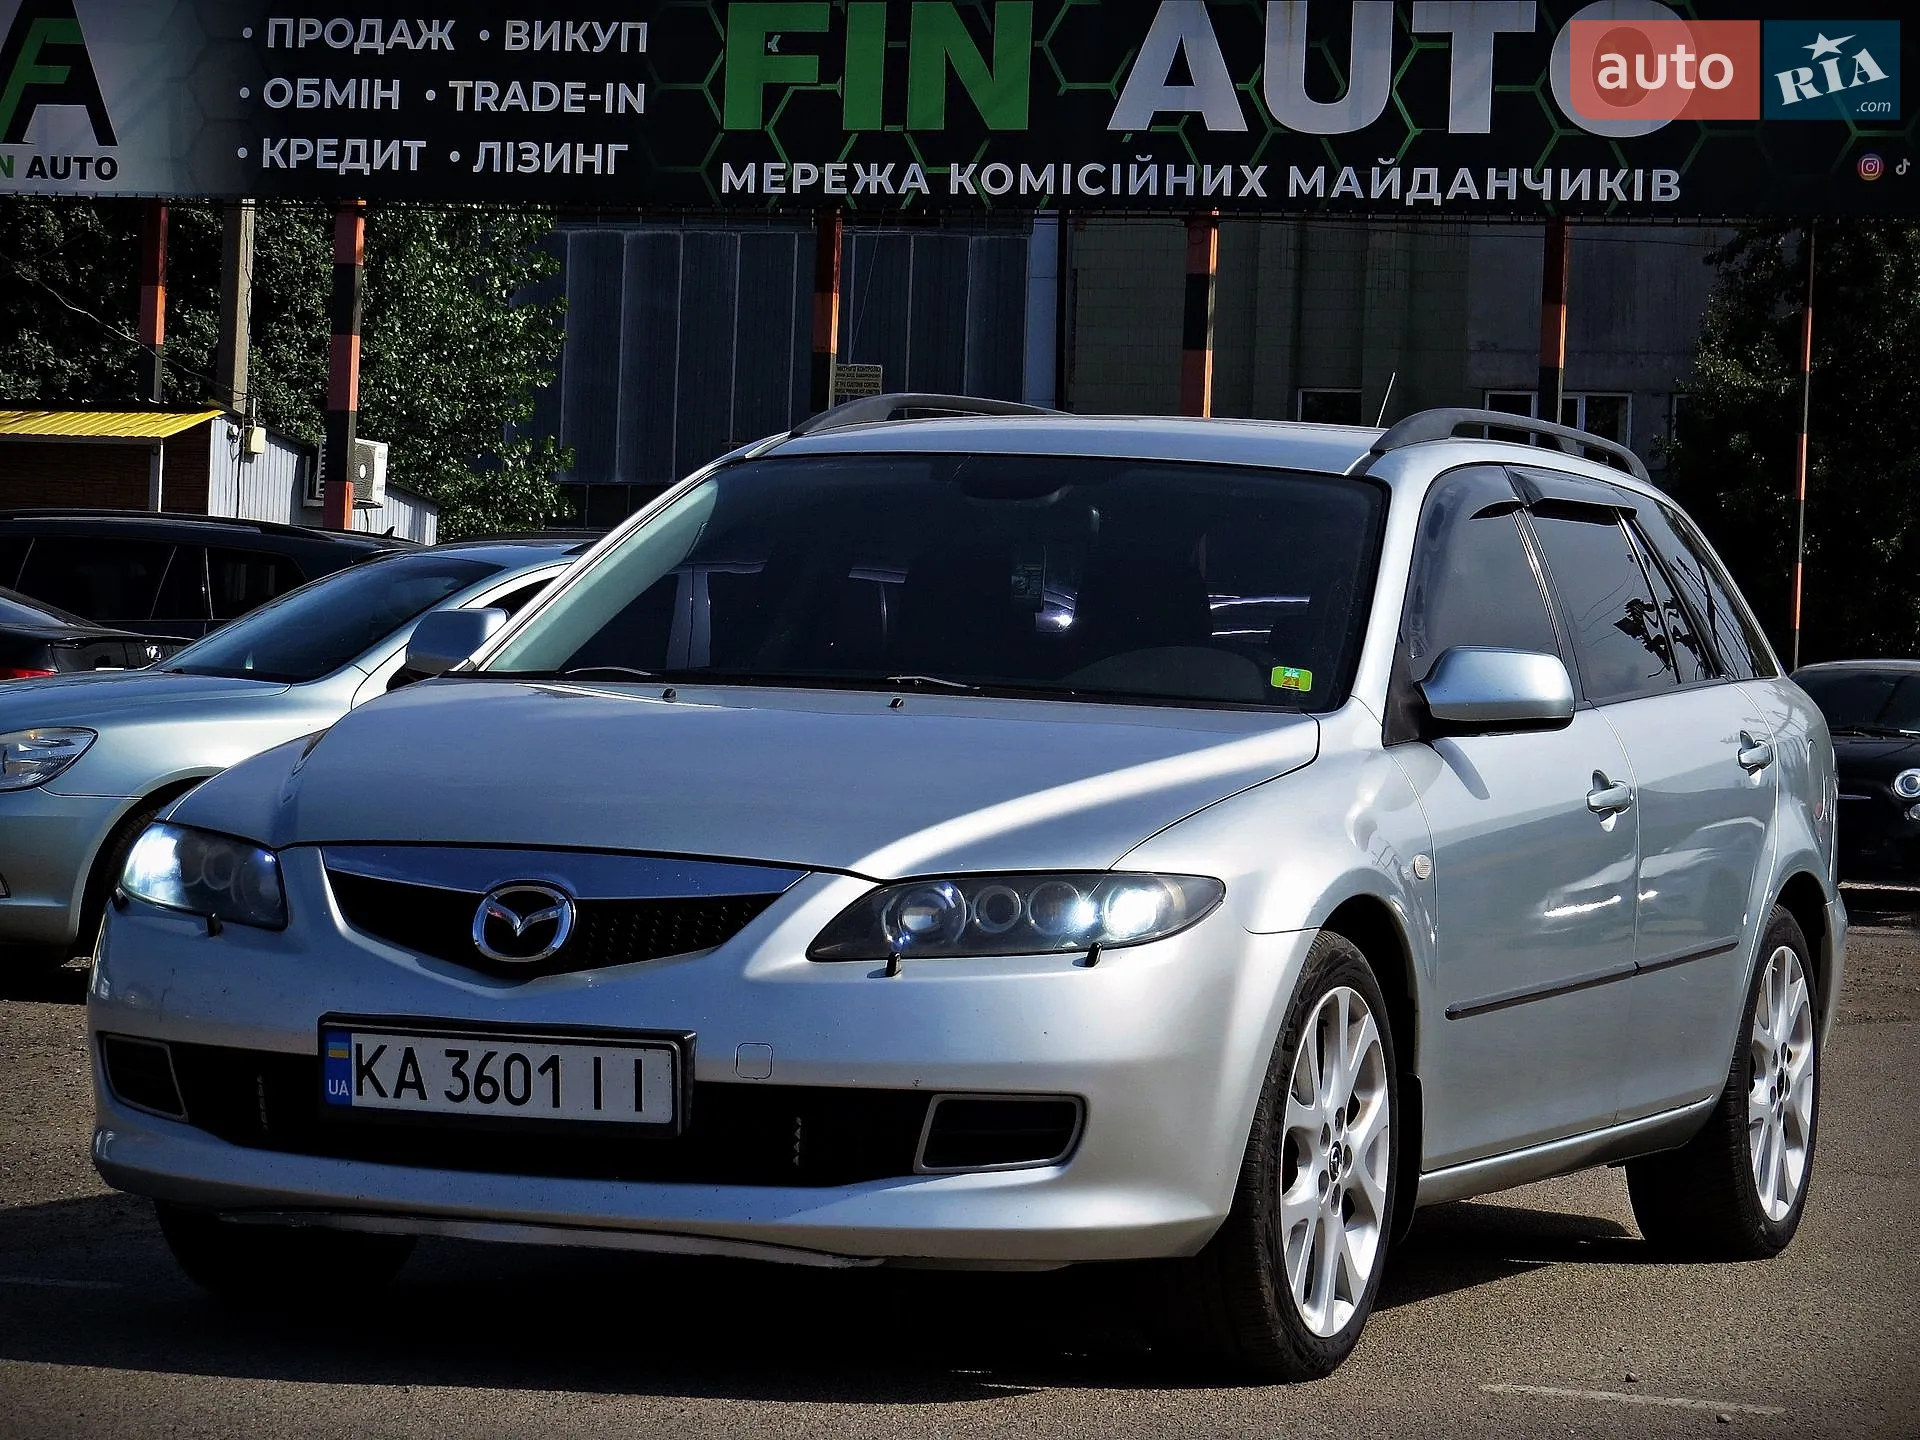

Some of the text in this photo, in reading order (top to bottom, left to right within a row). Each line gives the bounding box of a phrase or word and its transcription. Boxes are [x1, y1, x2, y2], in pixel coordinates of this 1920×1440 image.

[266, 17, 649, 55] ПРОДАЖ ВИКУП
[723, 0, 1697, 138] FIN AUTO
[263, 76, 401, 110] ОБМІН
[448, 80, 646, 115] TRADE-IN
[25, 155, 119, 181] AUTO
[262, 137, 629, 176] КРЕДИТ ЛІЗИНГ
[721, 154, 1682, 207] МЕРЕЖА КОМІСІЙНИХ МАЙДАНЧИКІВ
[328, 1079, 350, 1097] UA
[354, 1042, 428, 1101] KA
[443, 1048, 561, 1109] 3601
